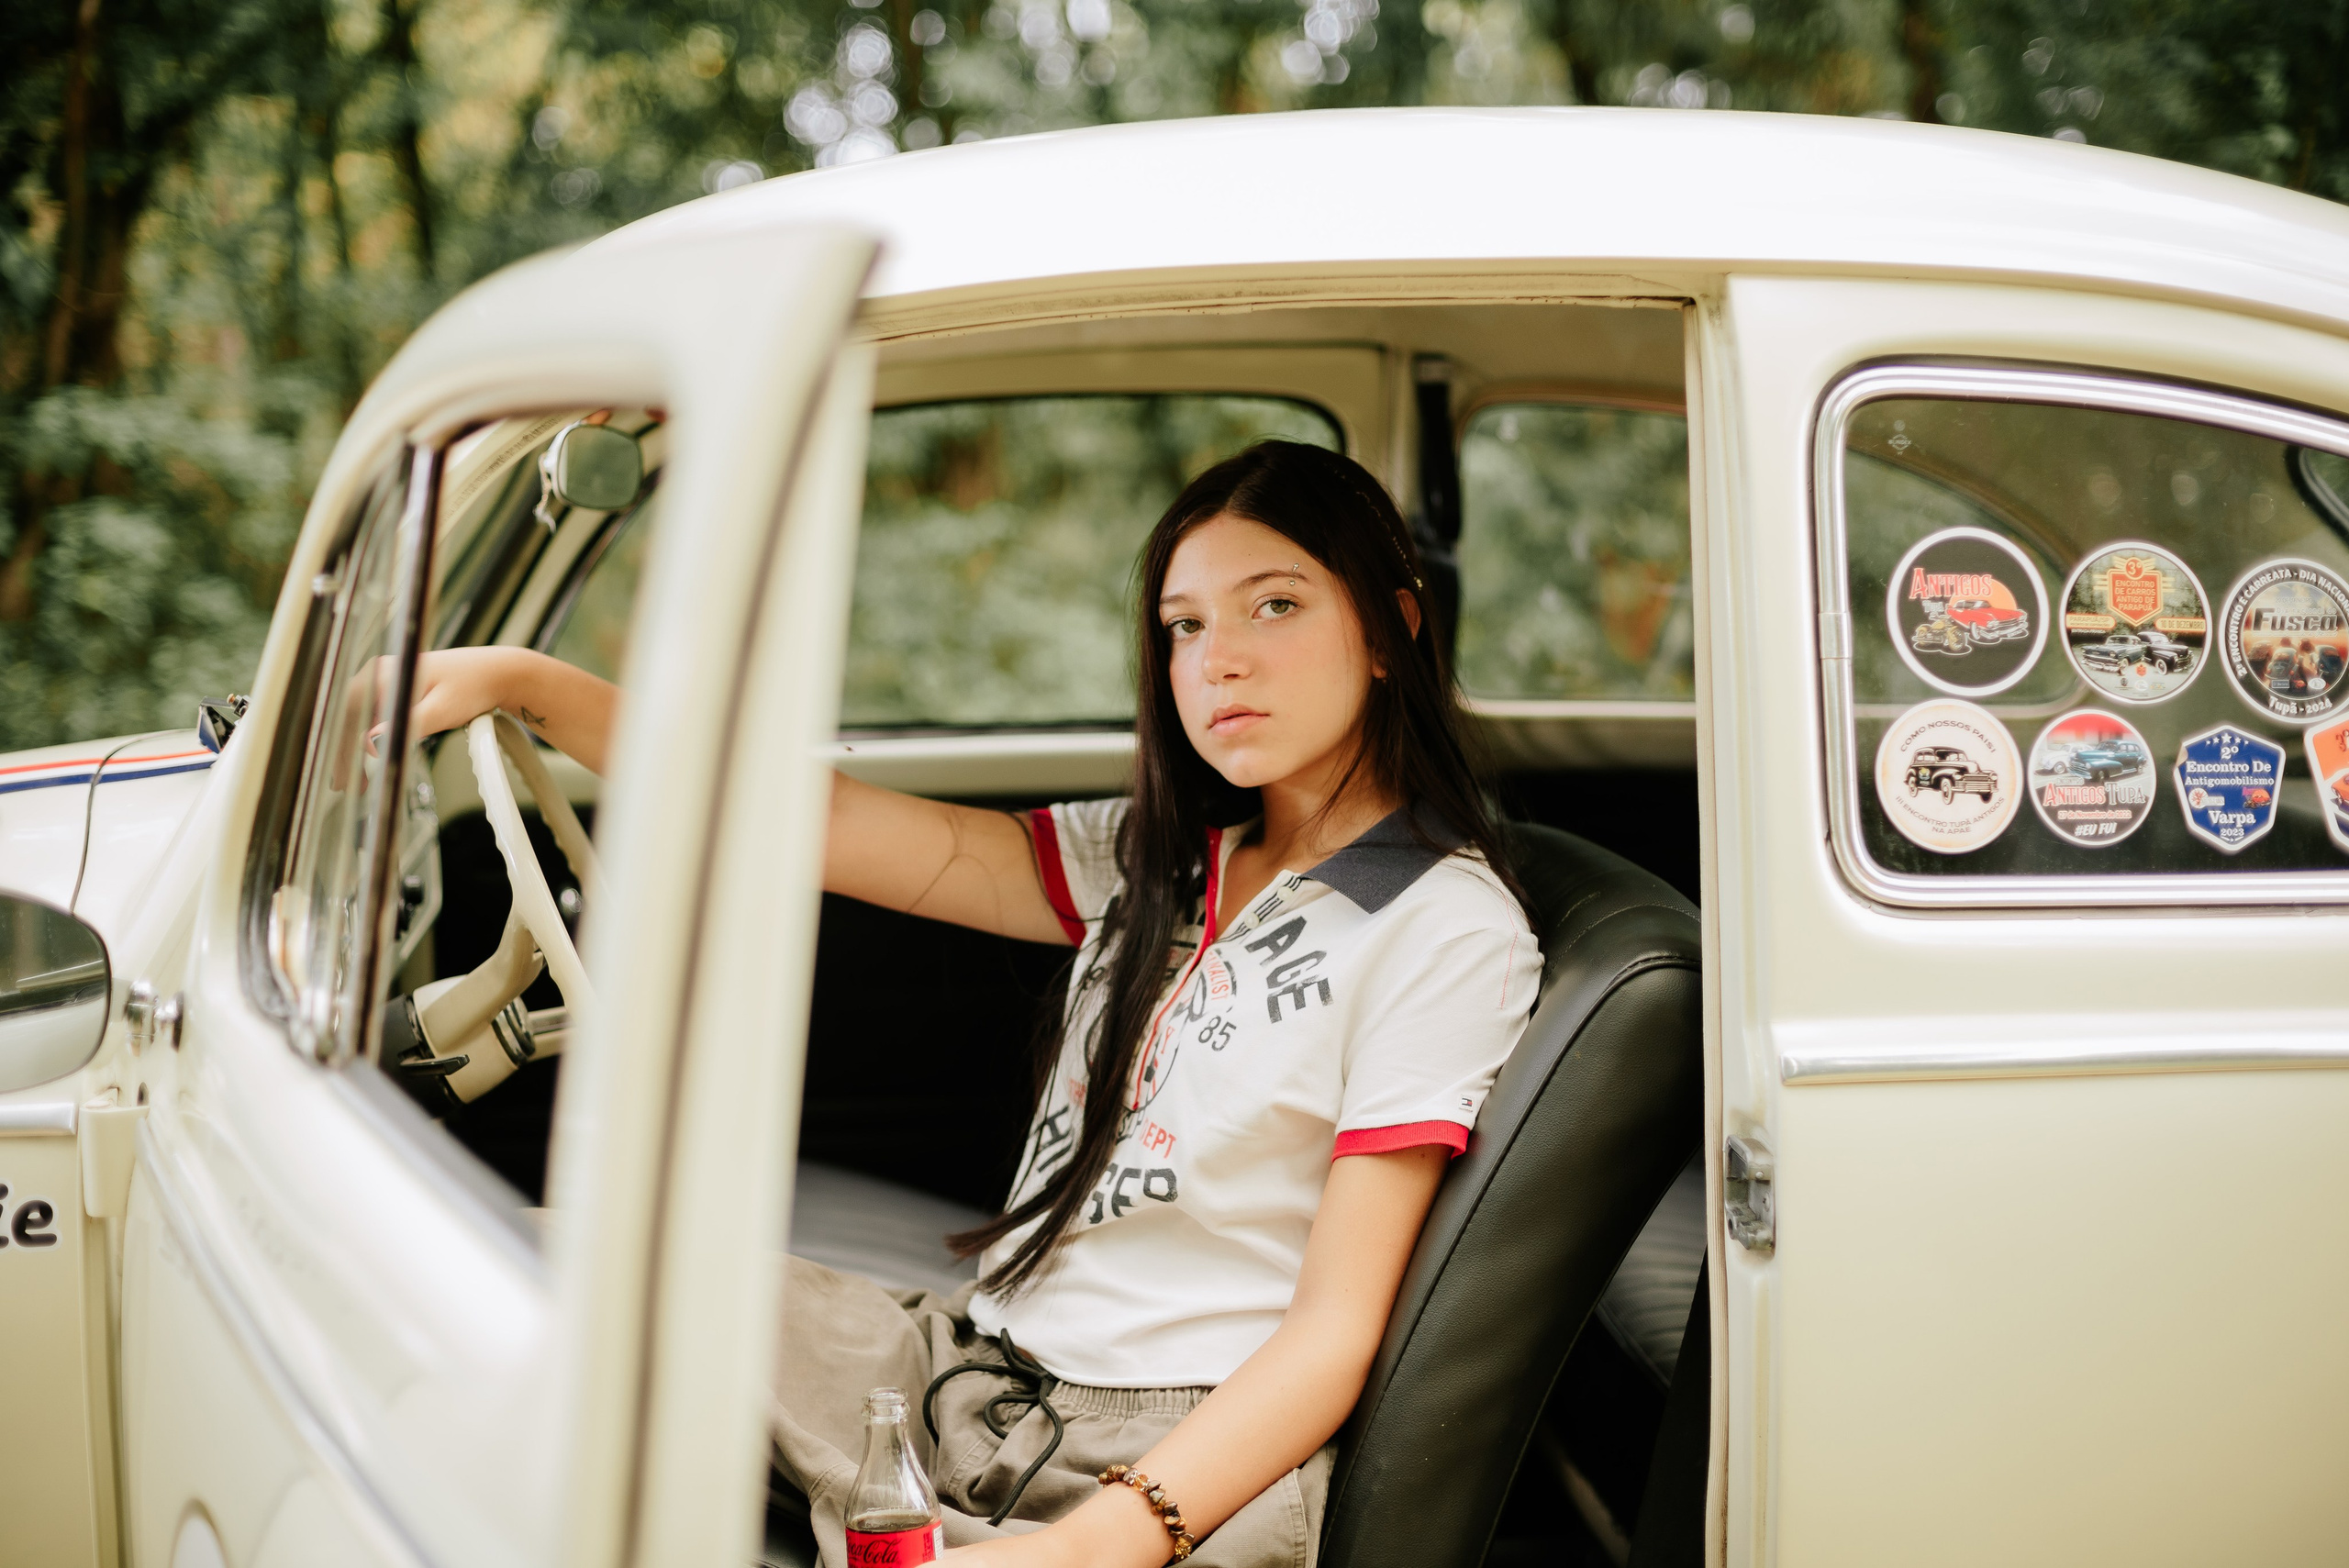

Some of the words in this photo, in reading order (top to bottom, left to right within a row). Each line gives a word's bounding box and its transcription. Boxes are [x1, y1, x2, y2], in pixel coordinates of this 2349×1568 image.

[1909, 567, 1992, 599] ANTIGOS
[2115, 580, 2155, 588] ENCONTRO
[2176, 620, 2205, 629] DEZEMBRO
[2229, 605, 2244, 662] ENCONTRO
[2239, 596, 2248, 606] E
[2244, 569, 2292, 598] CARREATA
[2299, 570, 2317, 583] DIA
[2253, 607, 2337, 631] Fusca
[2268, 695, 2298, 715] Tupã
[2306, 698, 2333, 714] 2024
[1900, 726, 1926, 752] COMO
[1928, 720, 1971, 731] NOSSOS
[2186, 761, 2249, 773] Encontro
[2252, 761, 2272, 773] De
[2185, 776, 2275, 787] Antigomobilismo
[2043, 783, 2106, 806] ANTIGOS
[1896, 795, 1904, 806] III
[1903, 804, 1947, 827] ENCONTRO
[1973, 796, 2005, 823] ANTIGOS
[2209, 810, 2256, 827] Varpa
[1947, 827, 1972, 835] APAE
[2075, 823, 2098, 836] #EU
[2098, 822, 2117, 835] FUI
[2221, 828, 2244, 837] 2023
[1197, 1015, 1237, 1052] 85
